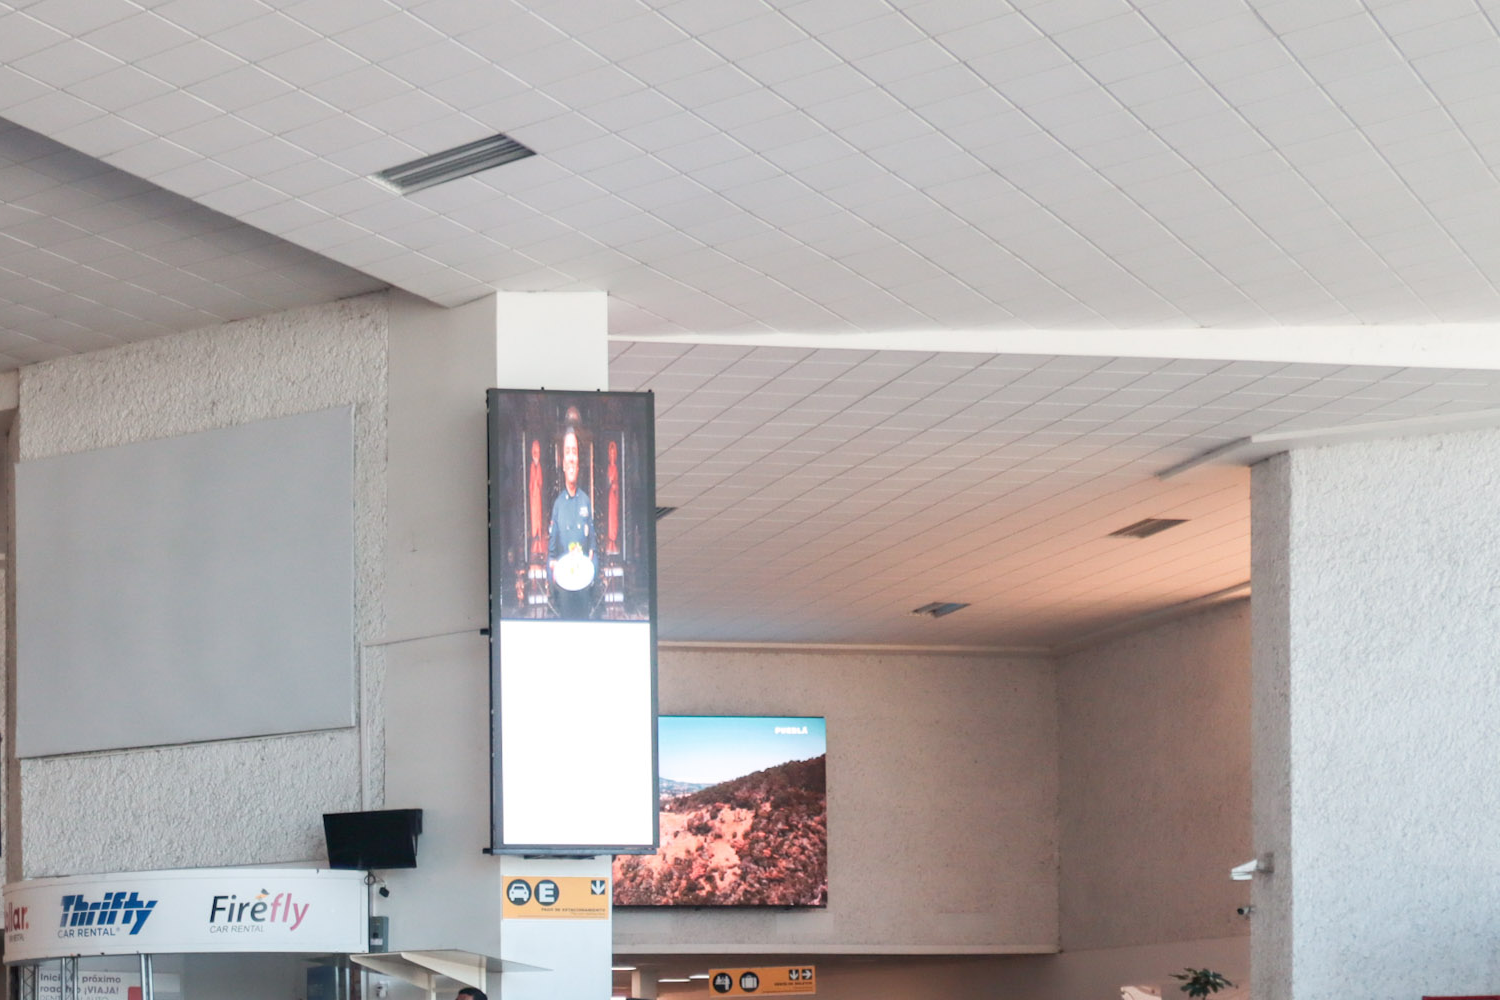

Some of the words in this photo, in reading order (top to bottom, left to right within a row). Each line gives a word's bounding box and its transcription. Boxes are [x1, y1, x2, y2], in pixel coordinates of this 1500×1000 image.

[539, 883, 555, 903] E
[59, 891, 159, 935] Thrifty
[209, 892, 310, 932] Firefly
[57, 928, 75, 939] CAR
[209, 925, 229, 934] CAR
[231, 924, 264, 933] RENTAL
